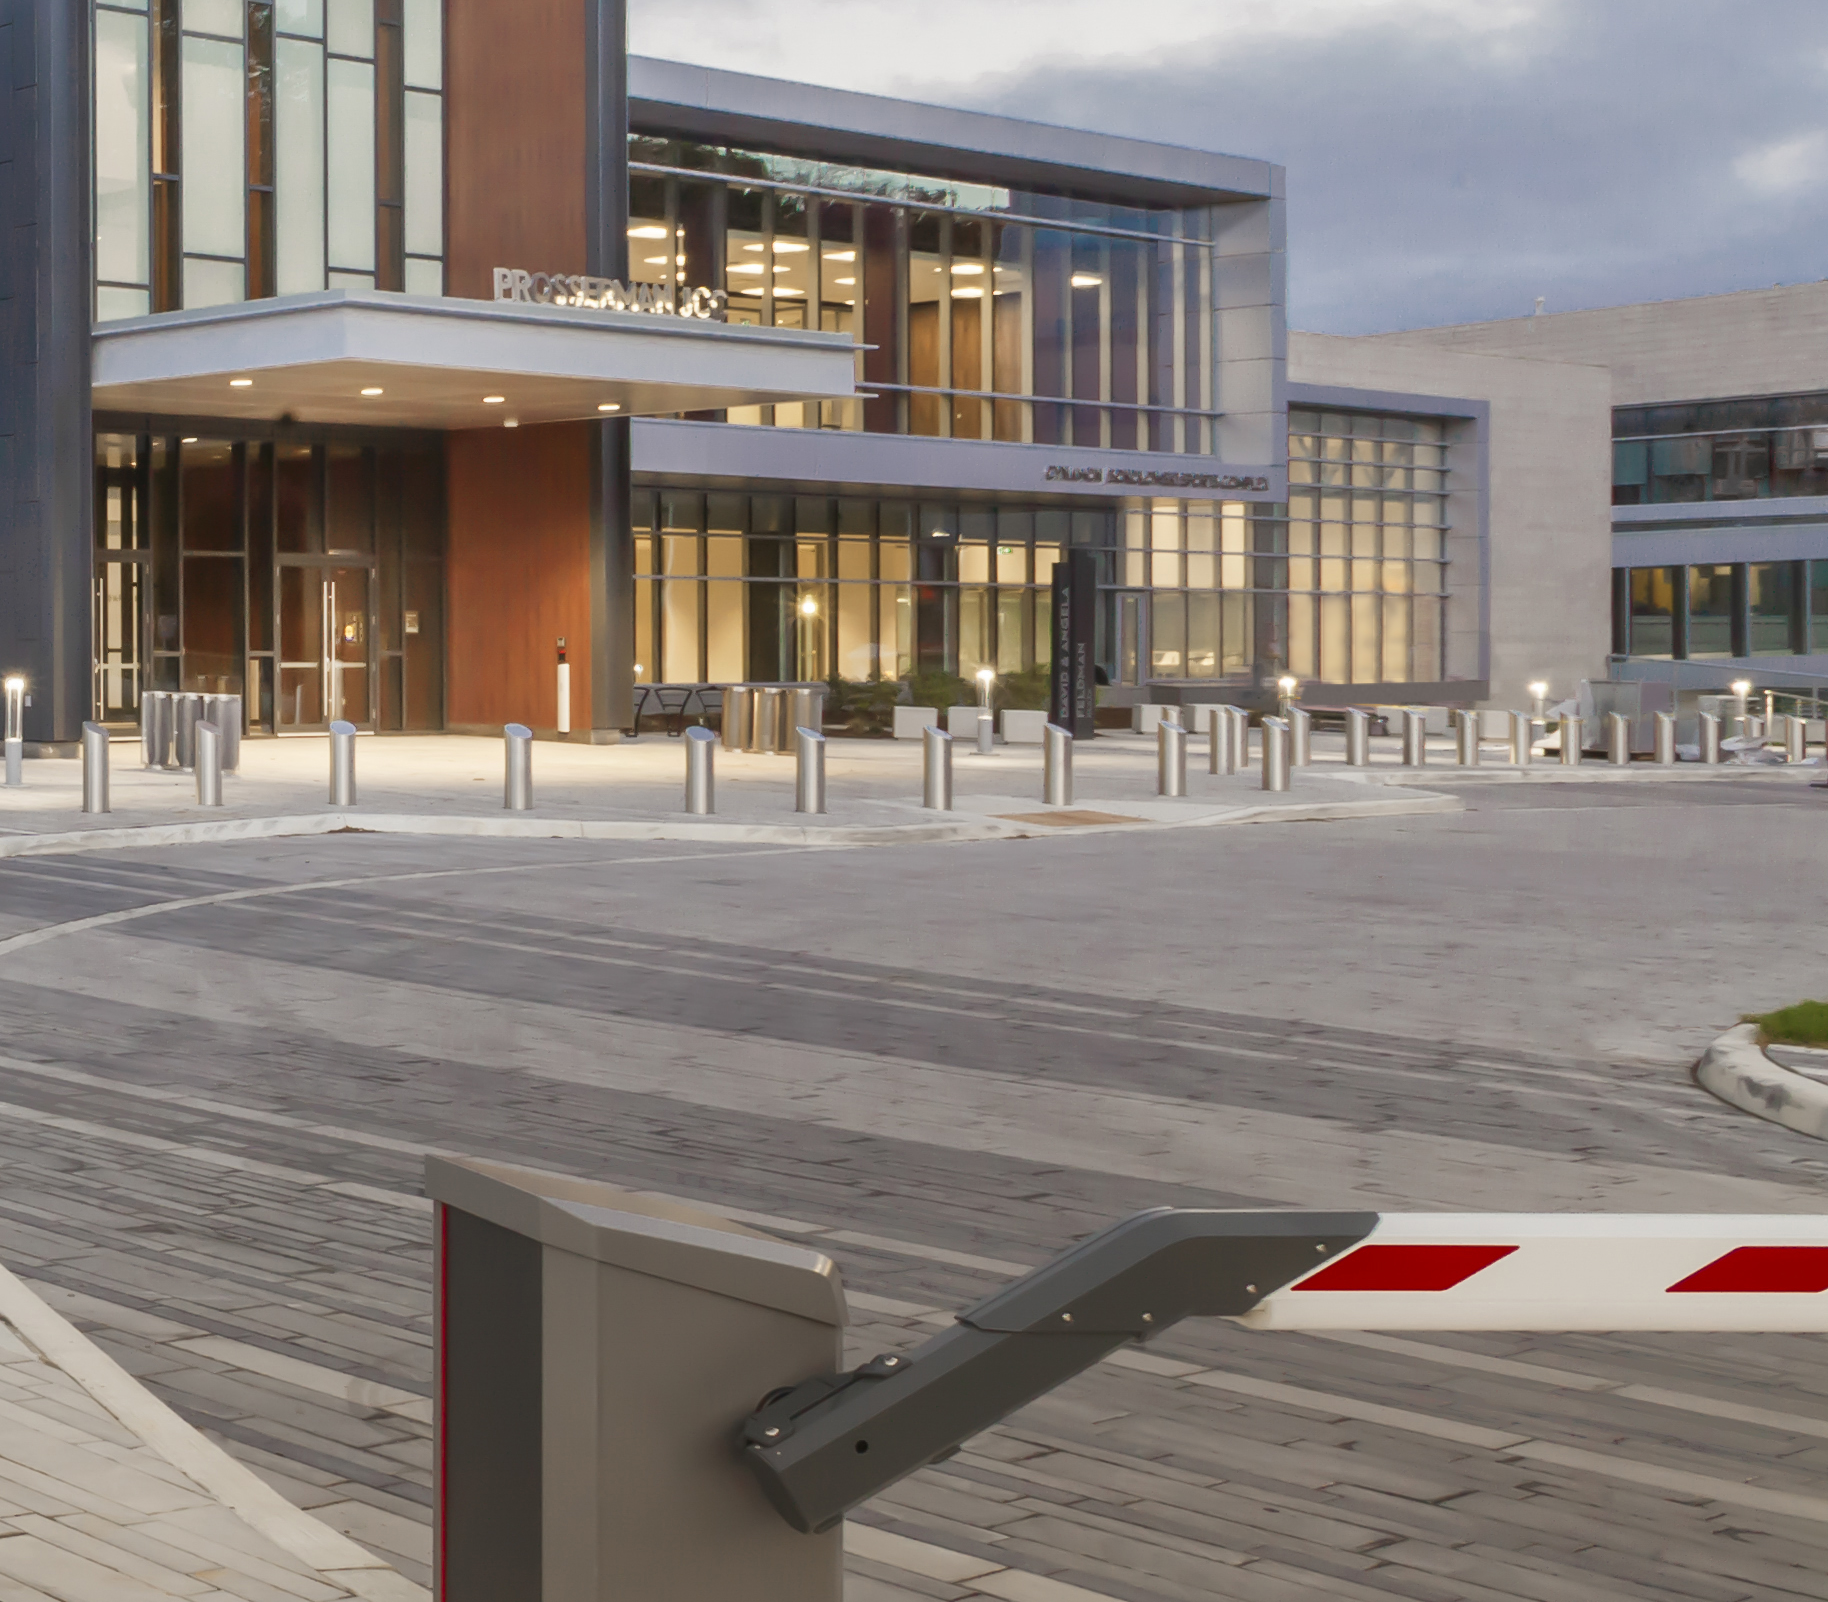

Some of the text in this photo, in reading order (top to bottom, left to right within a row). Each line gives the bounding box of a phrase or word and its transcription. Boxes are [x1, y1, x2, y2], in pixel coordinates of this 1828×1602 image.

[493, 267, 674, 315] PROSSERMAN
[1060, 587, 1069, 718] DAVID & ANGELA
[1077, 643, 1085, 718] FELDMAN
